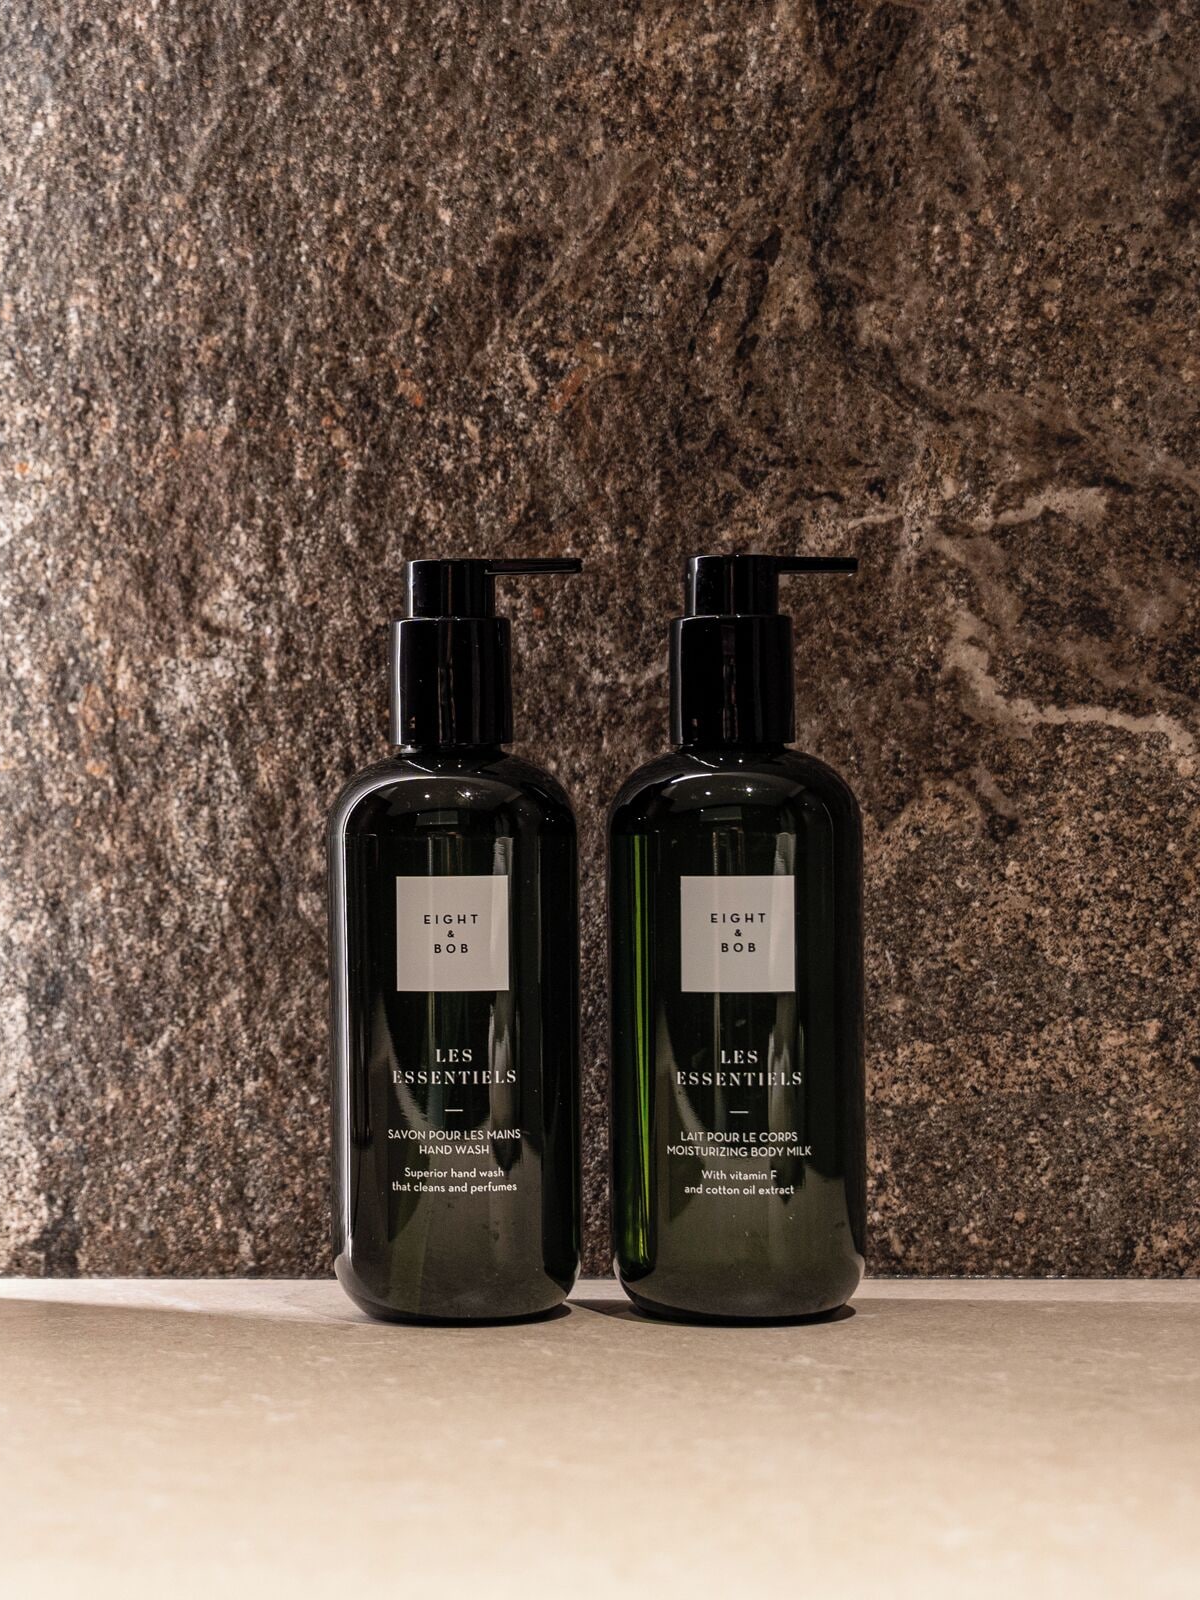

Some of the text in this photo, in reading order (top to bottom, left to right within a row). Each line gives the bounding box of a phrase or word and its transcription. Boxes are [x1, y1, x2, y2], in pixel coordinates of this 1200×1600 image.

[424, 914, 478, 924] EIGHT
[710, 913, 766, 923] EIGHT
[447, 930, 454, 938] &
[434, 944, 468, 954] BOB
[721, 943, 756, 952] BOB
[436, 1049, 473, 1062] LES
[721, 1050, 758, 1064] LES
[392, 1070, 516, 1084] ESSENTIELS
[676, 1071, 802, 1086] ESSENTIELS
[388, 1129, 521, 1140] SAVON POUR LES MAINS
[681, 1132, 798, 1142] LAIT POUR LE CORPS
[419, 1145, 489, 1155] HAND WASH
[667, 1145, 812, 1157] MOISTURIZING BODY MILK
[404, 1167, 504, 1179] Superior hand wash
[701, 1170, 776, 1180] With vitamin F
[392, 1181, 517, 1194] that cleans and perfumes
[684, 1184, 794, 1195] and cotton oil extract
